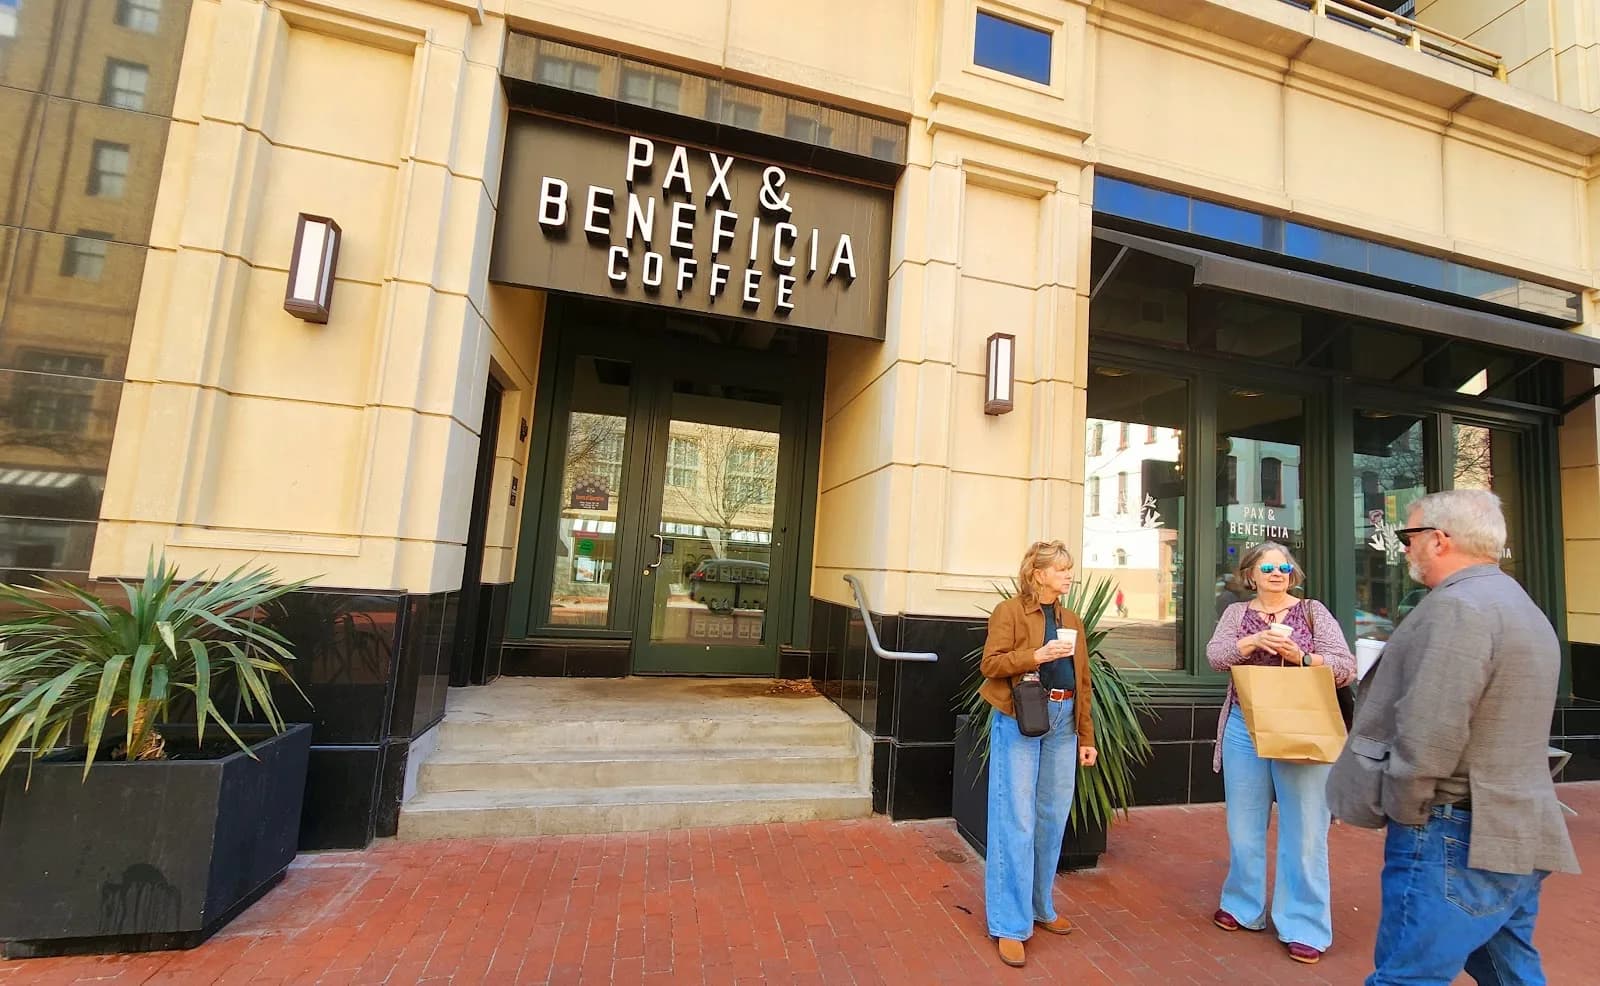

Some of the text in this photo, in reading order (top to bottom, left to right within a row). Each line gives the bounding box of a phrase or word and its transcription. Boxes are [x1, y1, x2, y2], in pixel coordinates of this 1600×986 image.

[626, 136, 793, 213] PAX &
[538, 176, 857, 280] BENEFICIA
[607, 245, 797, 310] COFFEE
[1230, 521, 1289, 539] BENEFICIA
[1243, 506, 1276, 521] PAX &
